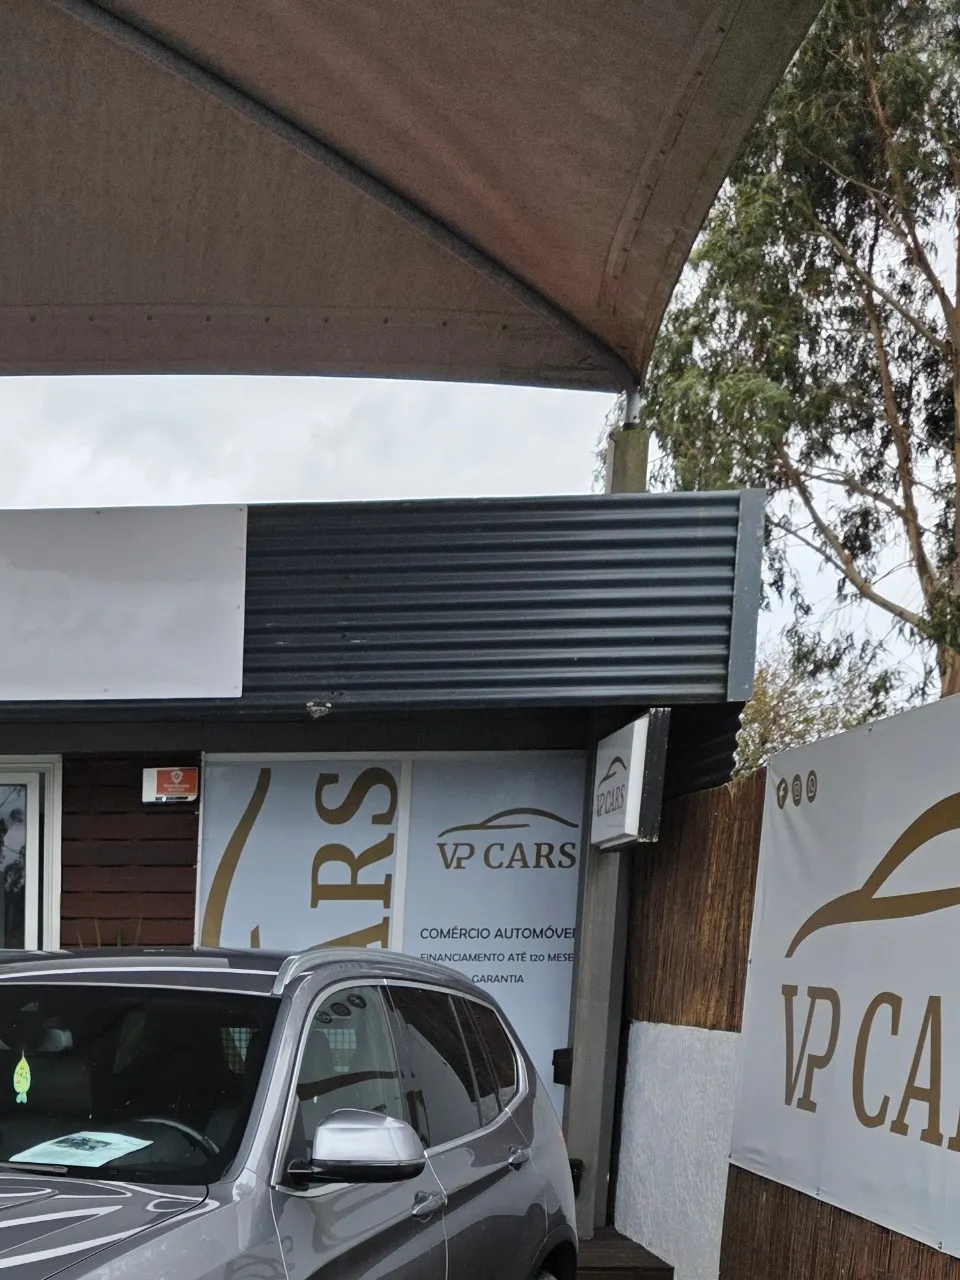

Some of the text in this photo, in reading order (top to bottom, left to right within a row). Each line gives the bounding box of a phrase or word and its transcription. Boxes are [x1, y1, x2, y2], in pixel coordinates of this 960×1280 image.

[605, 784, 626, 814] CARS
[436, 841, 577, 869] VP CARS
[420, 926, 491, 940] COMÉRCIO
[420, 952, 505, 963] FINANCIAMENTO
[507, 951, 527, 962] ATÉ
[530, 953, 545, 963] 120
[471, 974, 525, 984] GARANTIA
[781, 983, 960, 1153] VP CA
